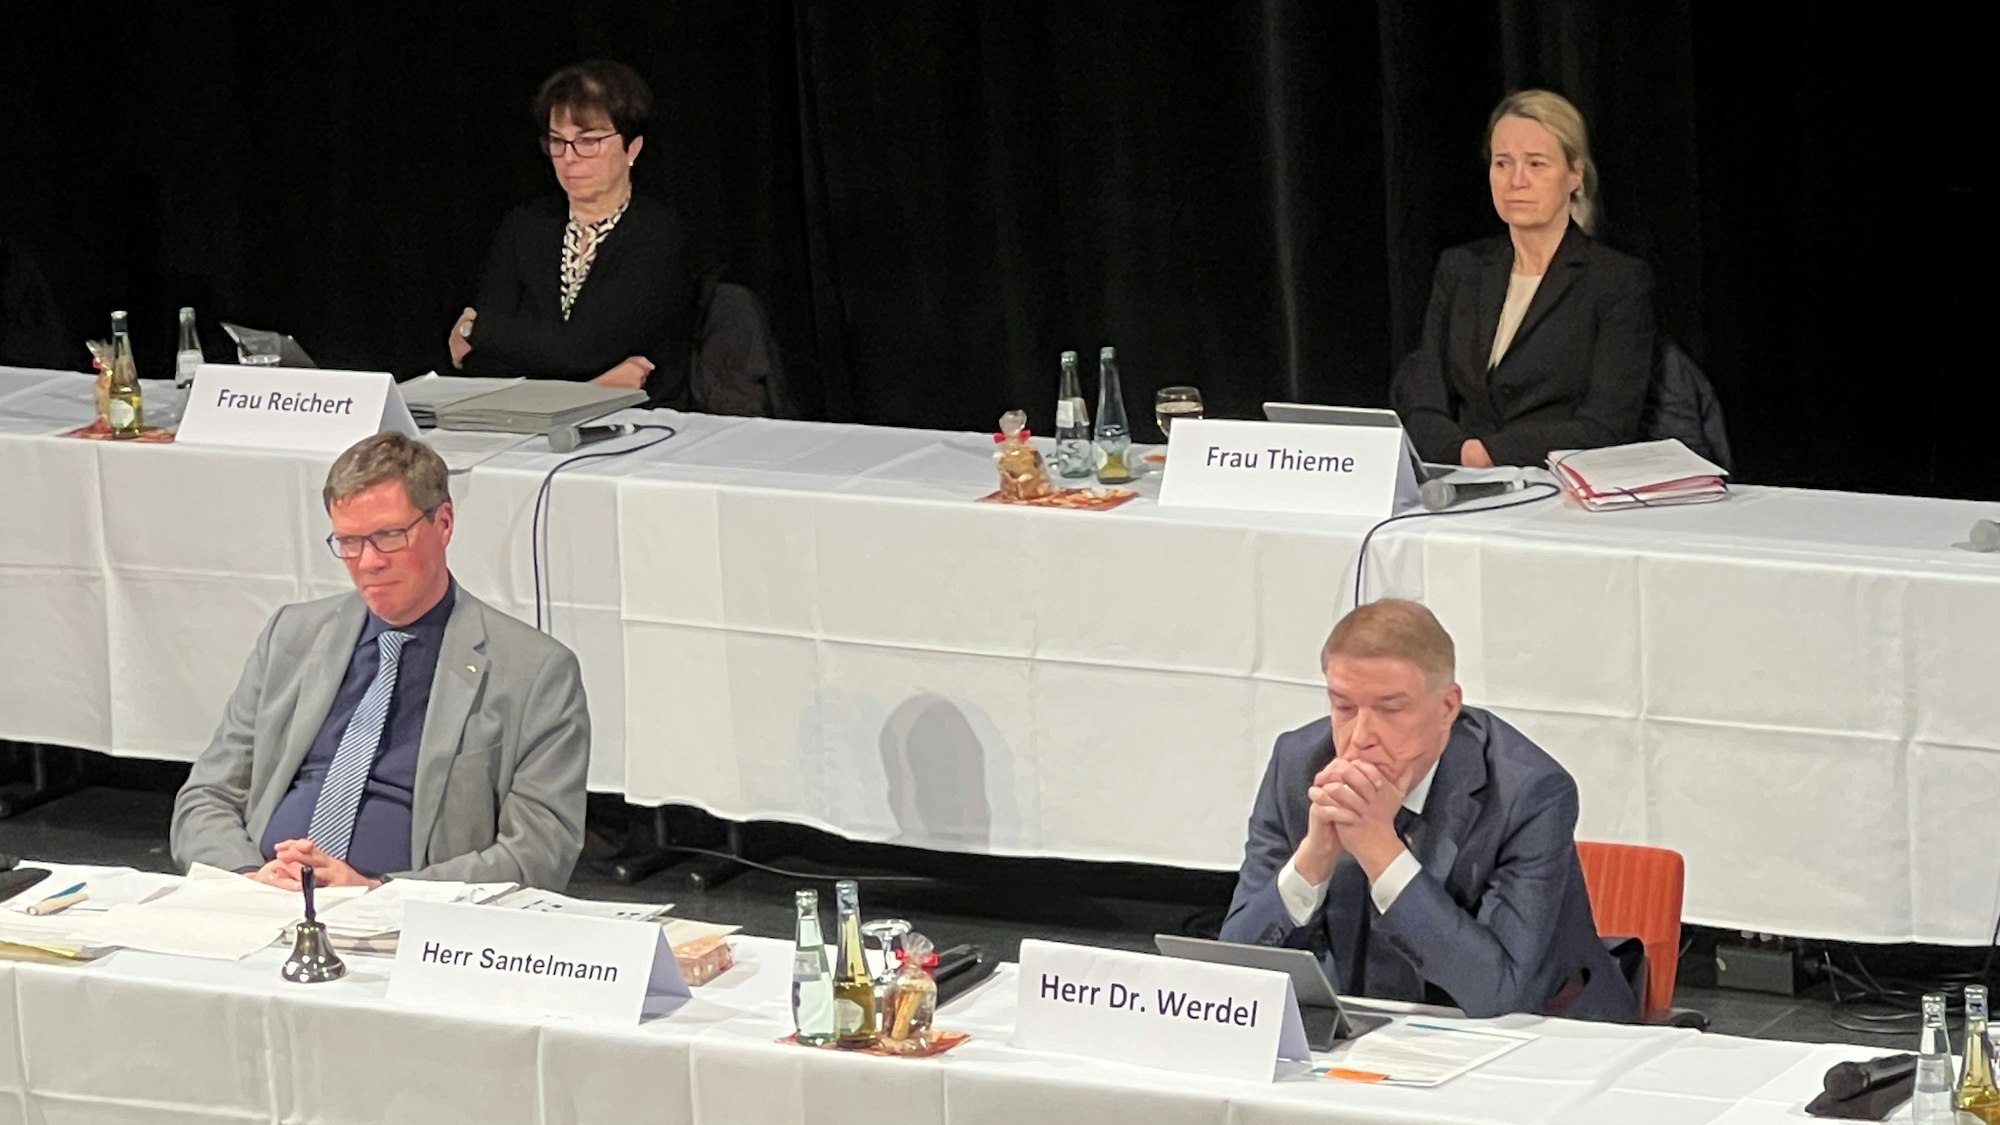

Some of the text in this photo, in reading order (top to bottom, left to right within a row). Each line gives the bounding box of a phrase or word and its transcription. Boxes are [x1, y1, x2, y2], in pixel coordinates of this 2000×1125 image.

[217, 388, 353, 415] Frau Reichert
[1206, 446, 1355, 473] Frau Thieme
[422, 941, 618, 983] Herr Santelmann
[1041, 973, 1258, 1028] Herr Dr. Werdel
